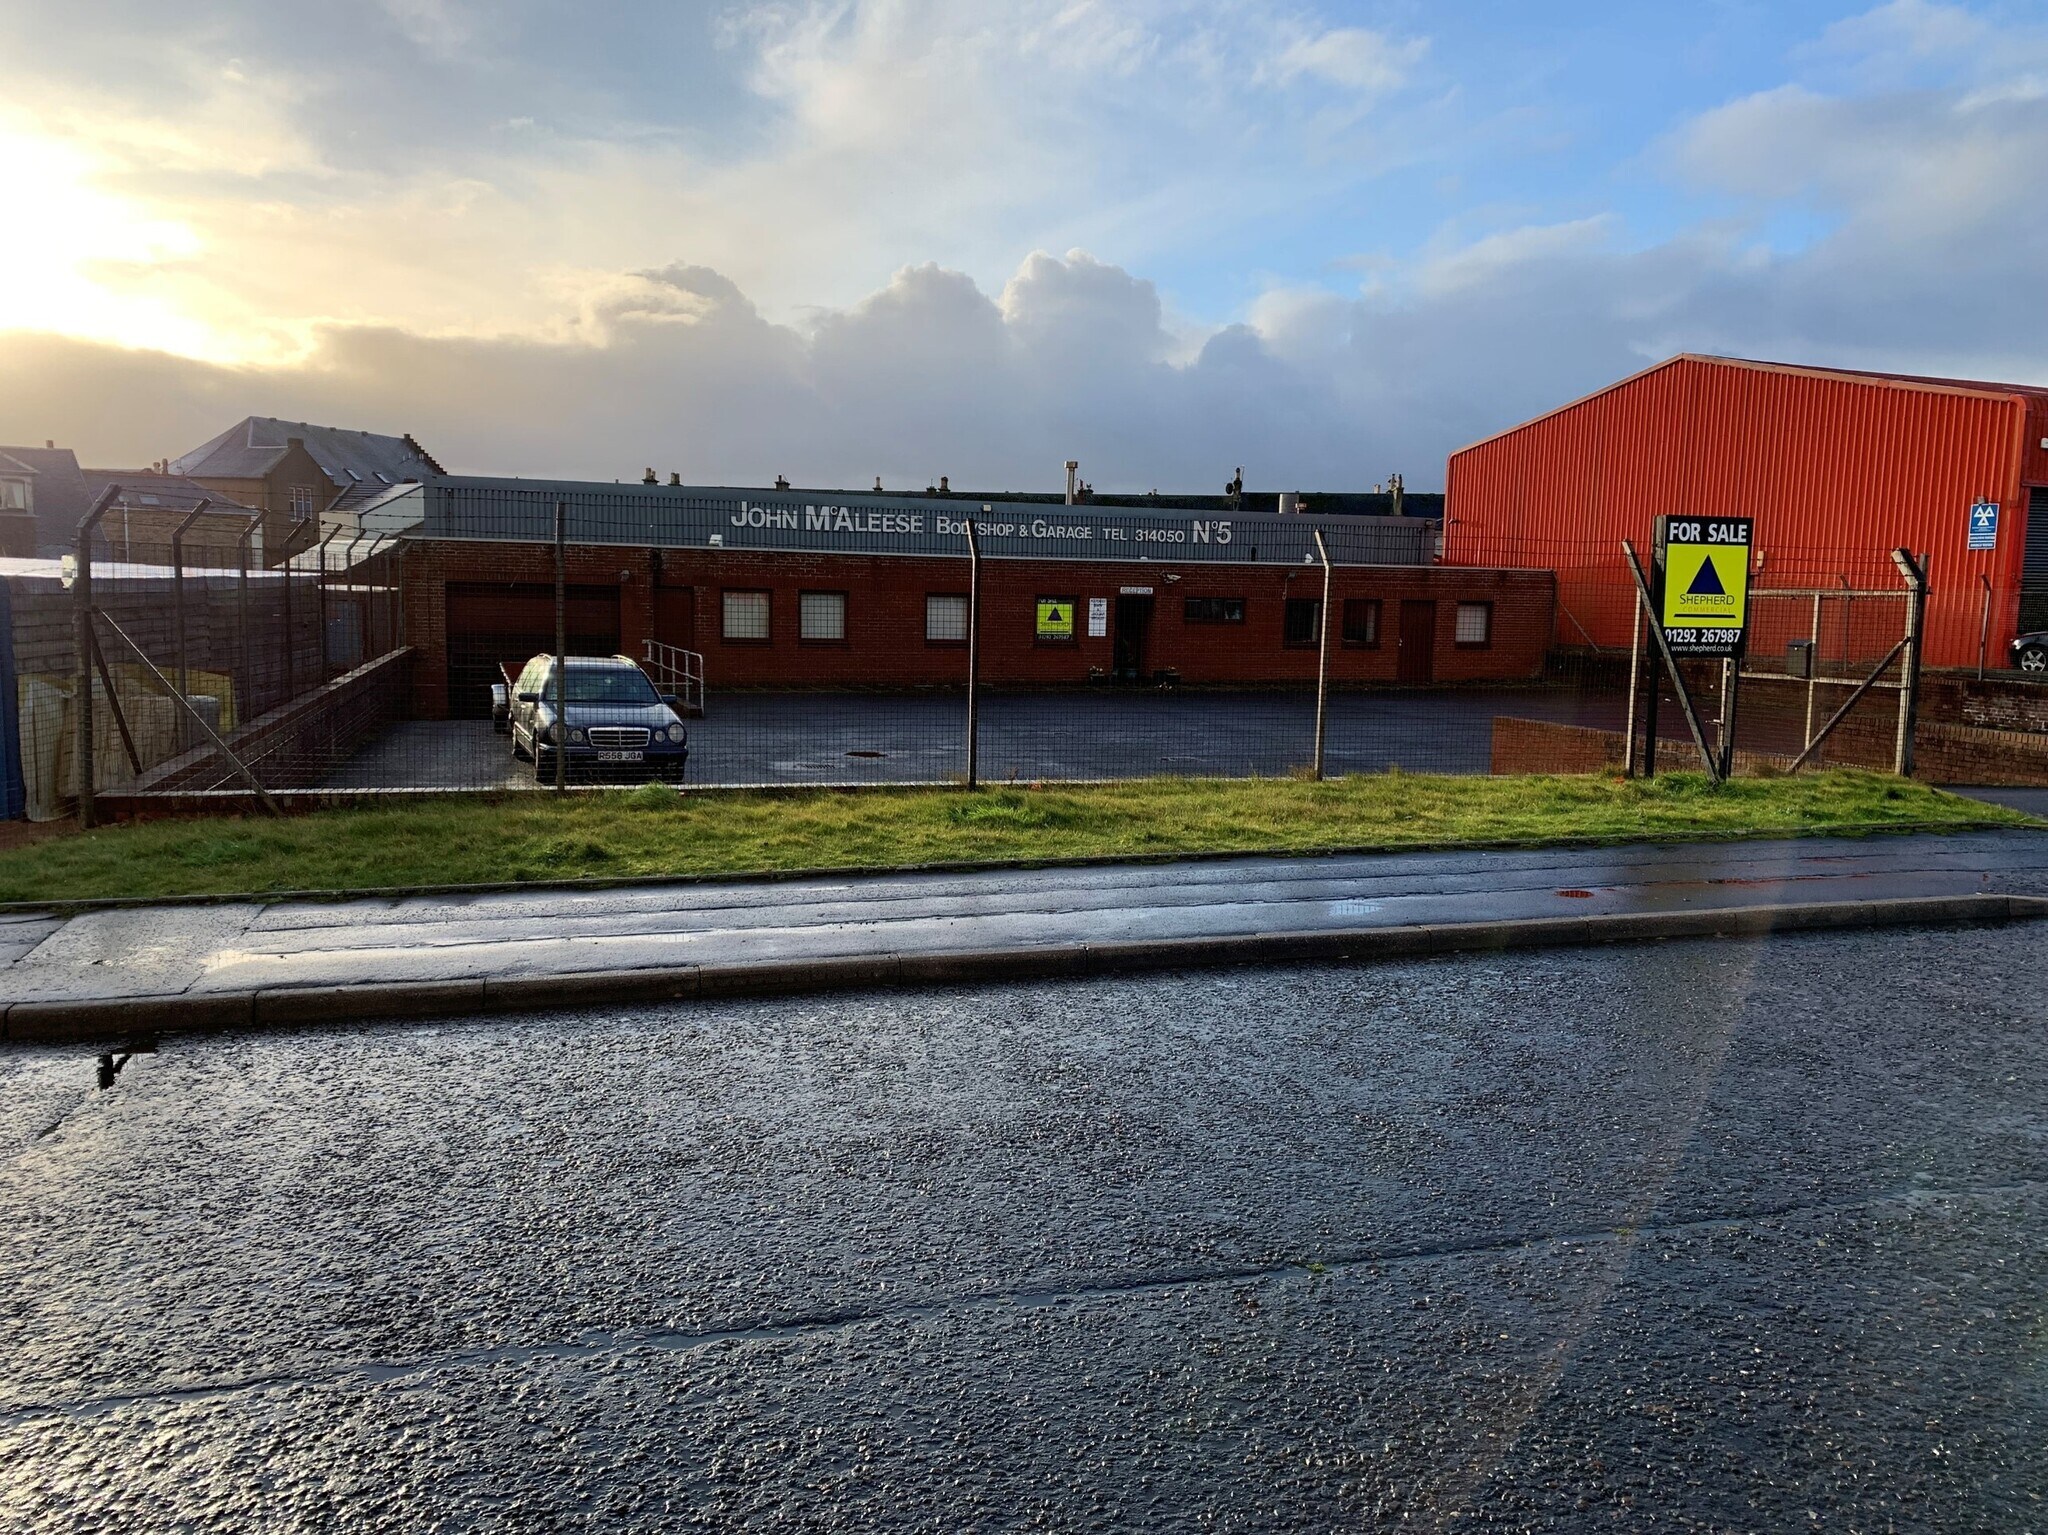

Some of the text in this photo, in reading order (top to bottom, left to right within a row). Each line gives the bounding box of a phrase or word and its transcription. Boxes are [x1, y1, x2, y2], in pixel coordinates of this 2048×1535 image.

[731, 501, 797, 529] JOHN
[936, 515, 1015, 537] BODSHOP
[1019, 525, 1029, 537] &
[1031, 519, 1093, 539] GARAGE
[1103, 528, 1127, 541] TEL
[1135, 530, 1185, 543] 314050
[1669, 522, 1748, 543] FOR SALE
[1680, 593, 1735, 605] SHEPHERD
[1665, 628, 1741, 643] 01292 267987
[1671, 644, 1733, 653] www.shepherd.co.uk
[624, 751, 642, 760] JGA
